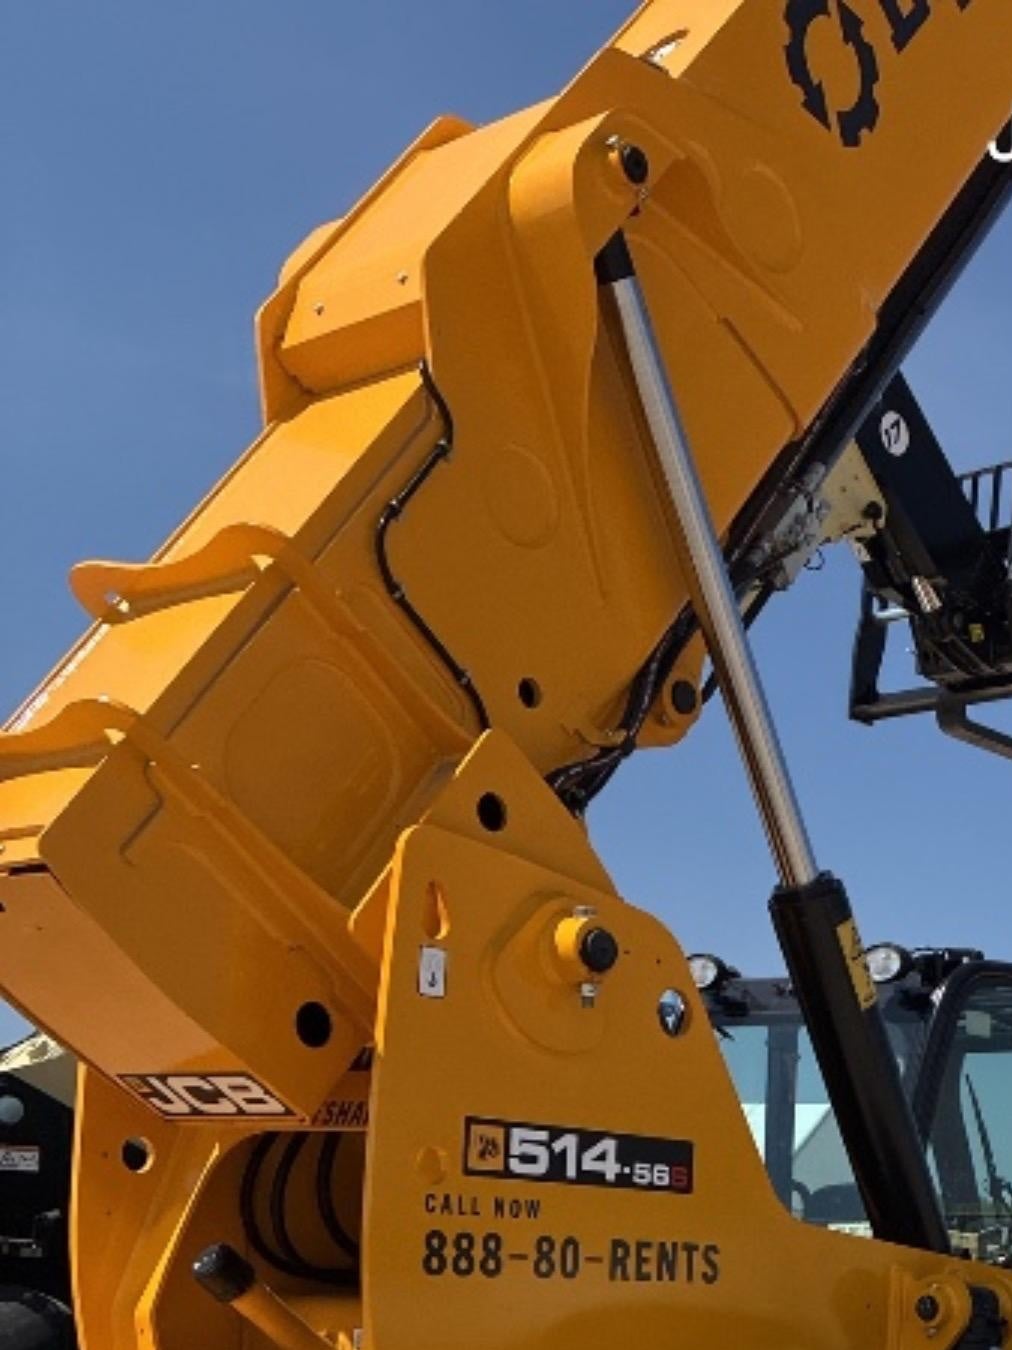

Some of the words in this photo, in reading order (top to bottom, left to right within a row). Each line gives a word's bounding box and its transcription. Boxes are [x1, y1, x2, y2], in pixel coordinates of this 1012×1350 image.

[147, 1075, 287, 1114] JCB
[425, 1194, 480, 1216] CALL
[495, 1198, 541, 1219] NOW
[422, 1230, 720, 1284] 888-80-RENTS
